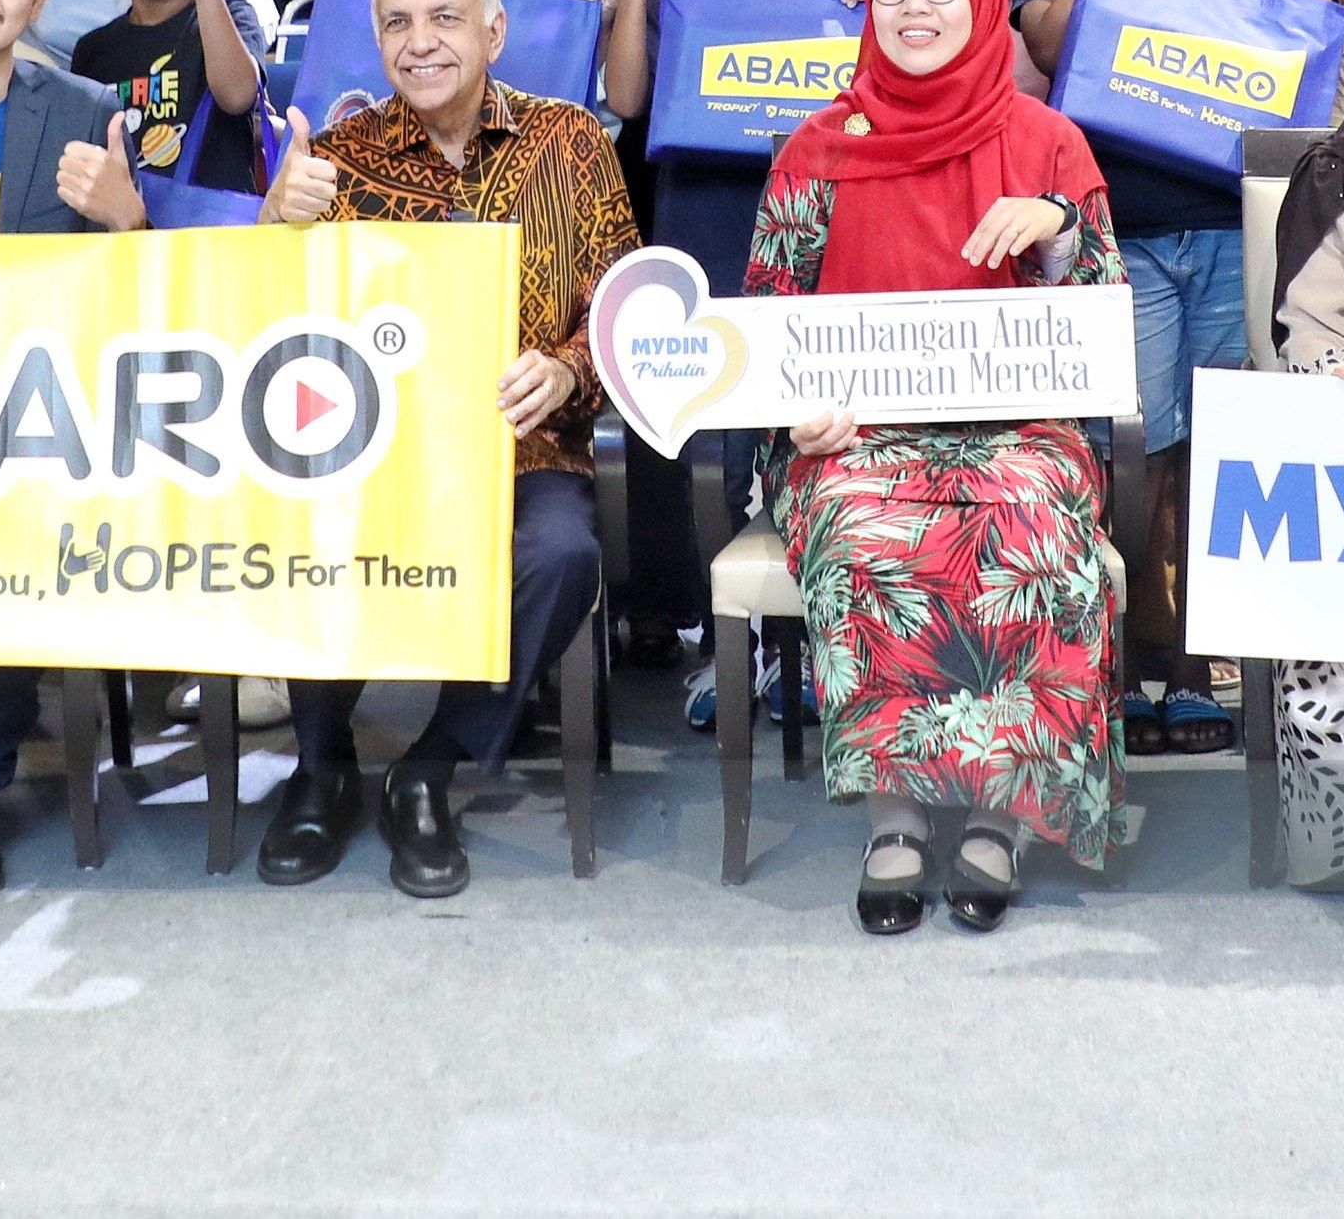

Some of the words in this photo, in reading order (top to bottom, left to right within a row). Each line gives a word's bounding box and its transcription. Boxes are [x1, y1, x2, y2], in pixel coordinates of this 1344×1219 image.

[1108, 78, 1160, 104] SHOES
[1160, 97, 1177, 112] For
[1131, 37, 1277, 102] ABARO
[631, 336, 708, 356] MYDIN
[785, 312, 979, 362] Sumbangan
[992, 306, 1084, 353] Anda,
[632, 361, 707, 380] Prihatin
[781, 357, 957, 409] Senyuman
[968, 351, 1093, 396] Mereka
[56, 522, 275, 596] HOPES
[288, 555, 346, 589] For
[355, 555, 458, 589] Them
